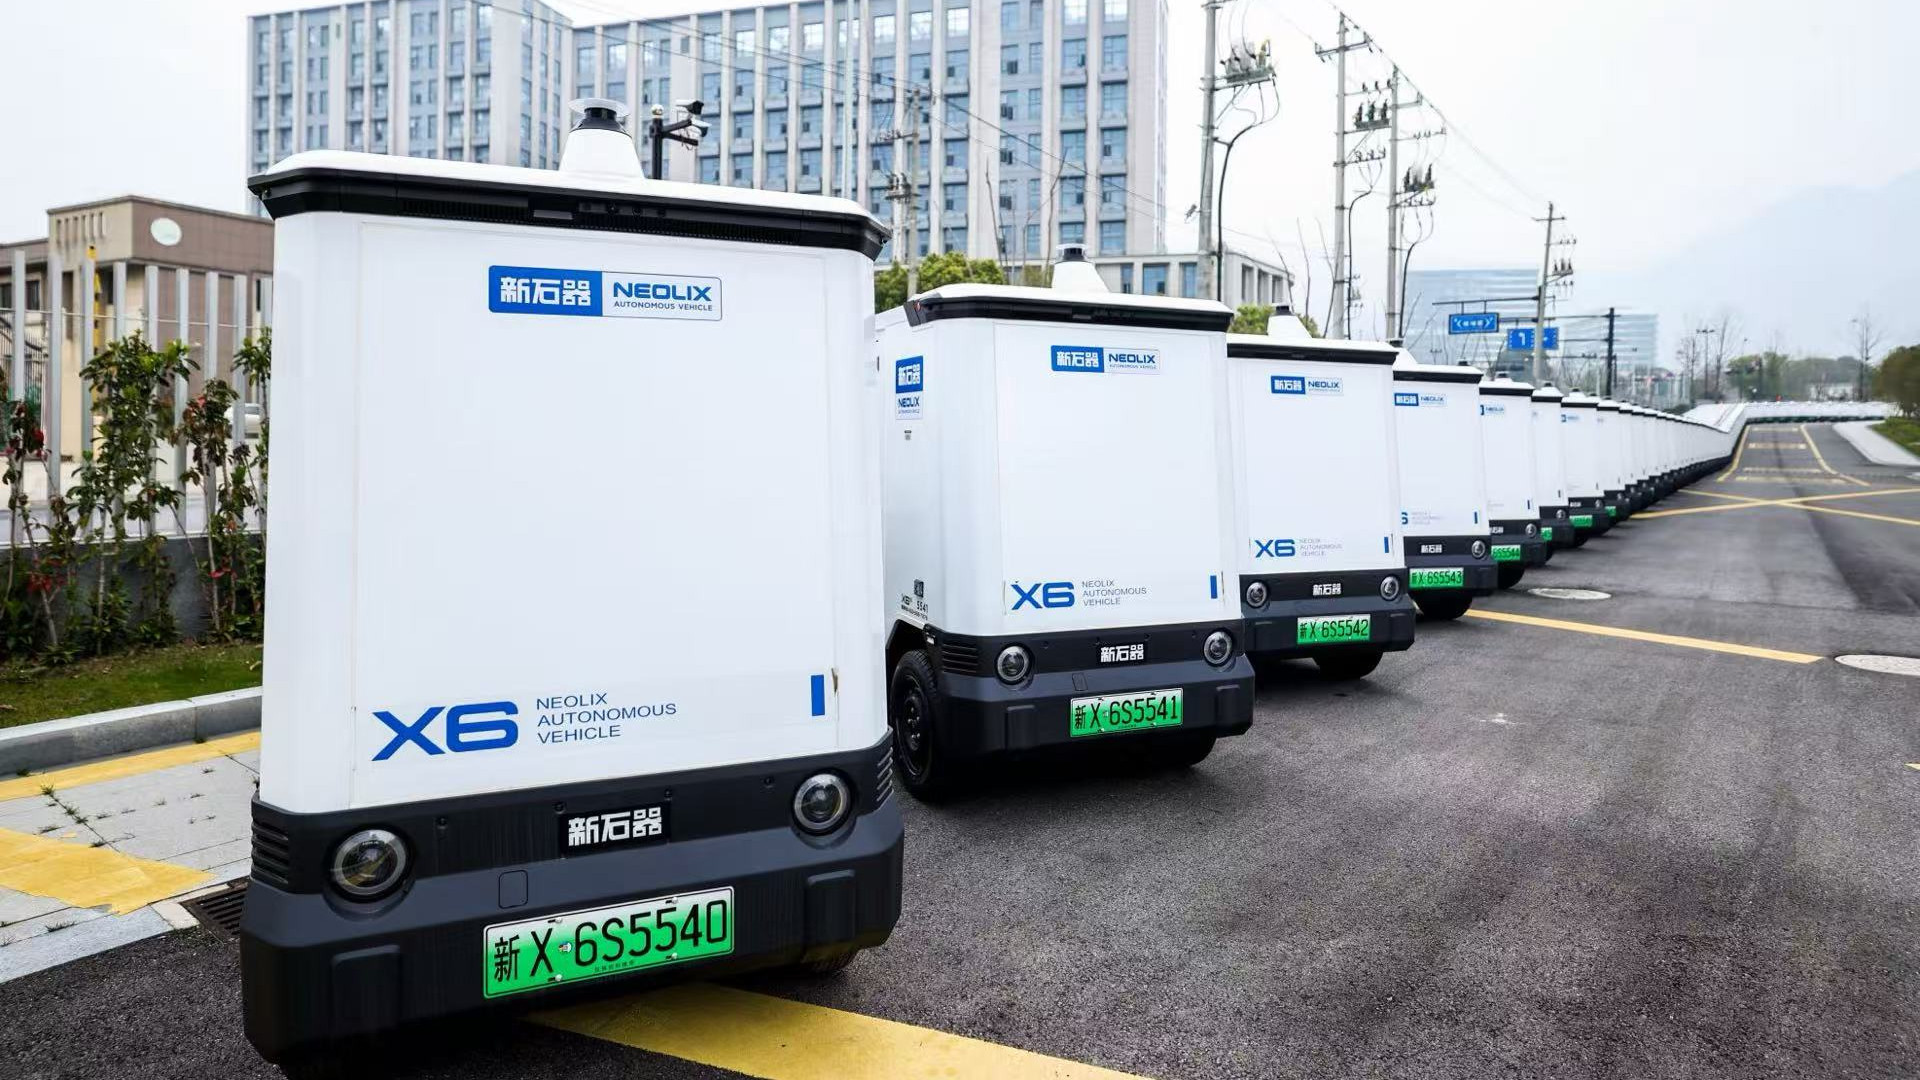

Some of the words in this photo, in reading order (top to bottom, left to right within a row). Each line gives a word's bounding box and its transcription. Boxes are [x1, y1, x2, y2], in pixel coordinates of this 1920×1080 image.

[500, 276, 591, 306] 新石器
[613, 282, 712, 301] NEOLIX
[614, 300, 676, 310] AUTONOMOUS
[678, 303, 713, 312] VEHICLE
[1056, 351, 1099, 367] 新石器
[1108, 354, 1156, 364] NEOLIX
[1255, 539, 1296, 558] X6
[1082, 580, 1115, 588] NEOLIX
[1082, 588, 1147, 598] AUTONOMOUS
[1313, 583, 1342, 596] 新石器
[1010, 582, 1075, 610] X6
[1083, 598, 1120, 606] VEHICLE
[1100, 644, 1144, 662] 新石器
[536, 692, 607, 710] NEOLIX
[538, 702, 677, 727] AUTONOMOUS
[1109, 696, 1178, 726] 6S5541
[372, 702, 518, 761] X6
[538, 724, 621, 744] VEHICLE
[568, 806, 662, 846] 新石器
[574, 899, 727, 967] 6S5540
